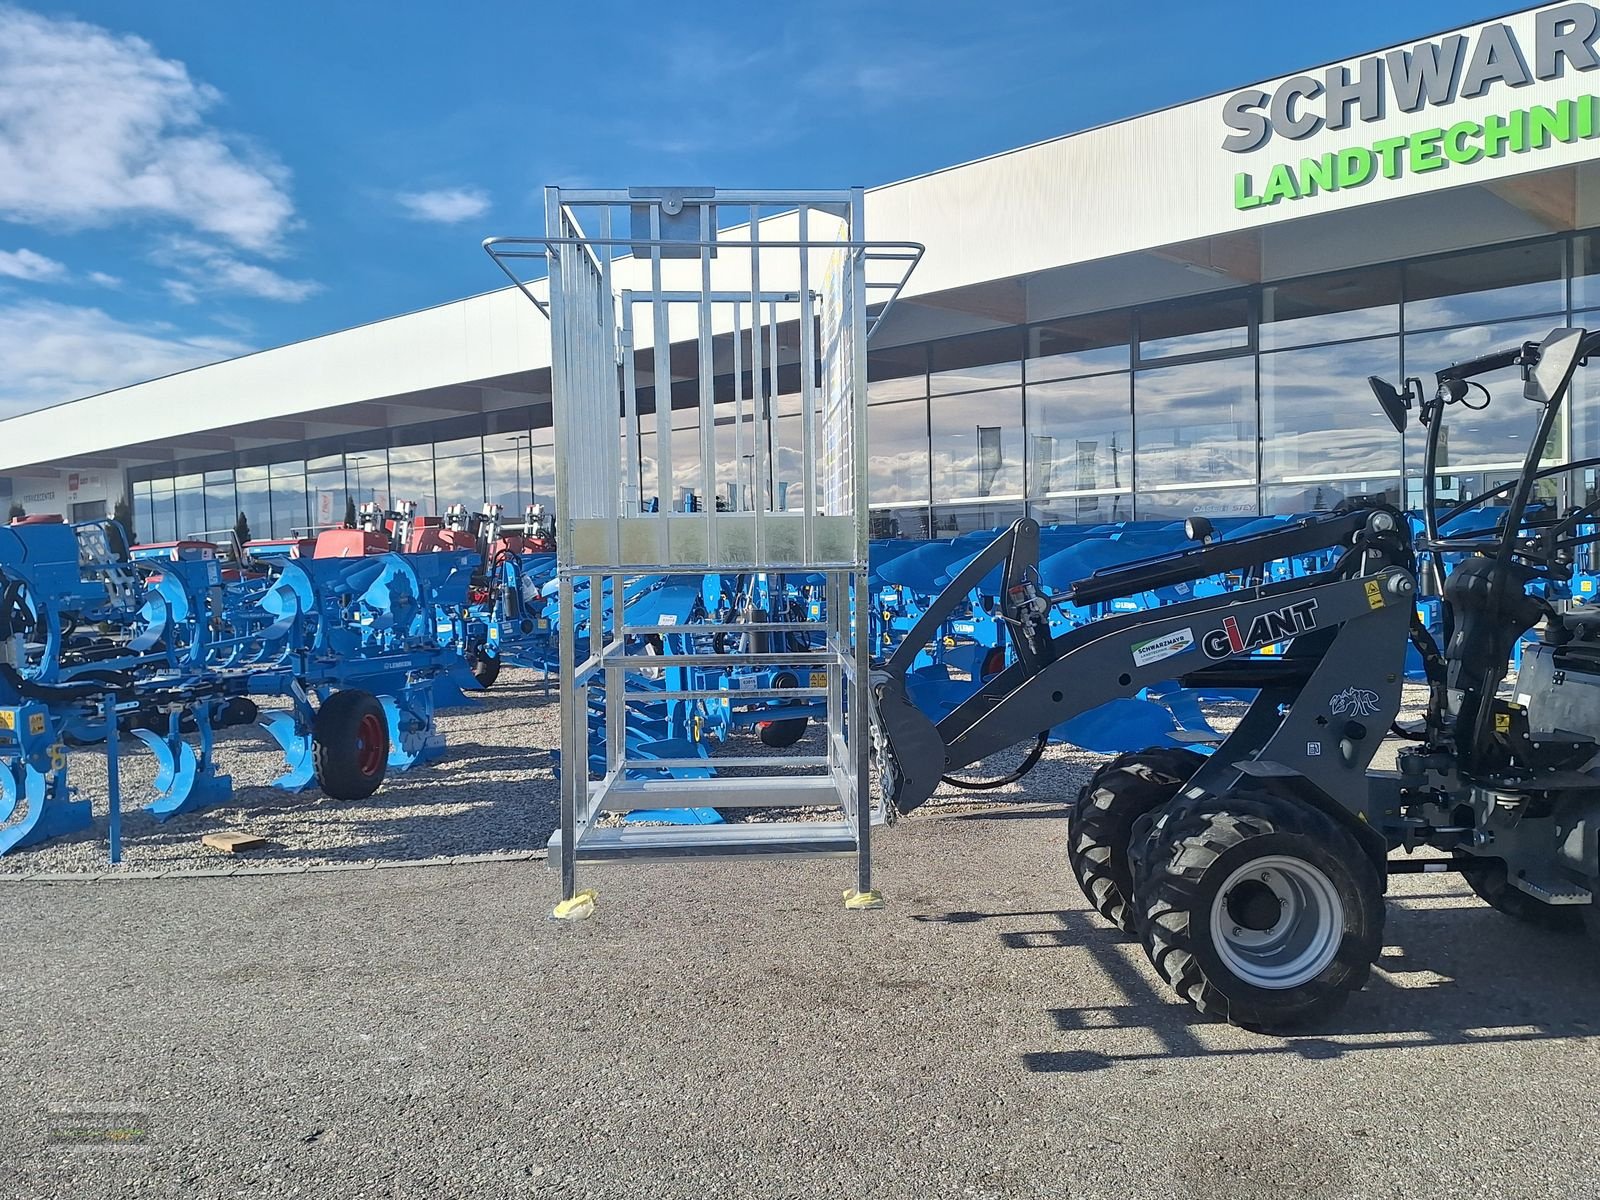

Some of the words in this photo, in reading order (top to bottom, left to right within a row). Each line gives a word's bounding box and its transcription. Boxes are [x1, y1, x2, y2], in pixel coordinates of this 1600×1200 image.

[1221, 3, 1600, 153] SCHWAR
[1234, 94, 1594, 210] LANDTECHNI
[1138, 635, 1185, 654] SCHWARZMAYR
